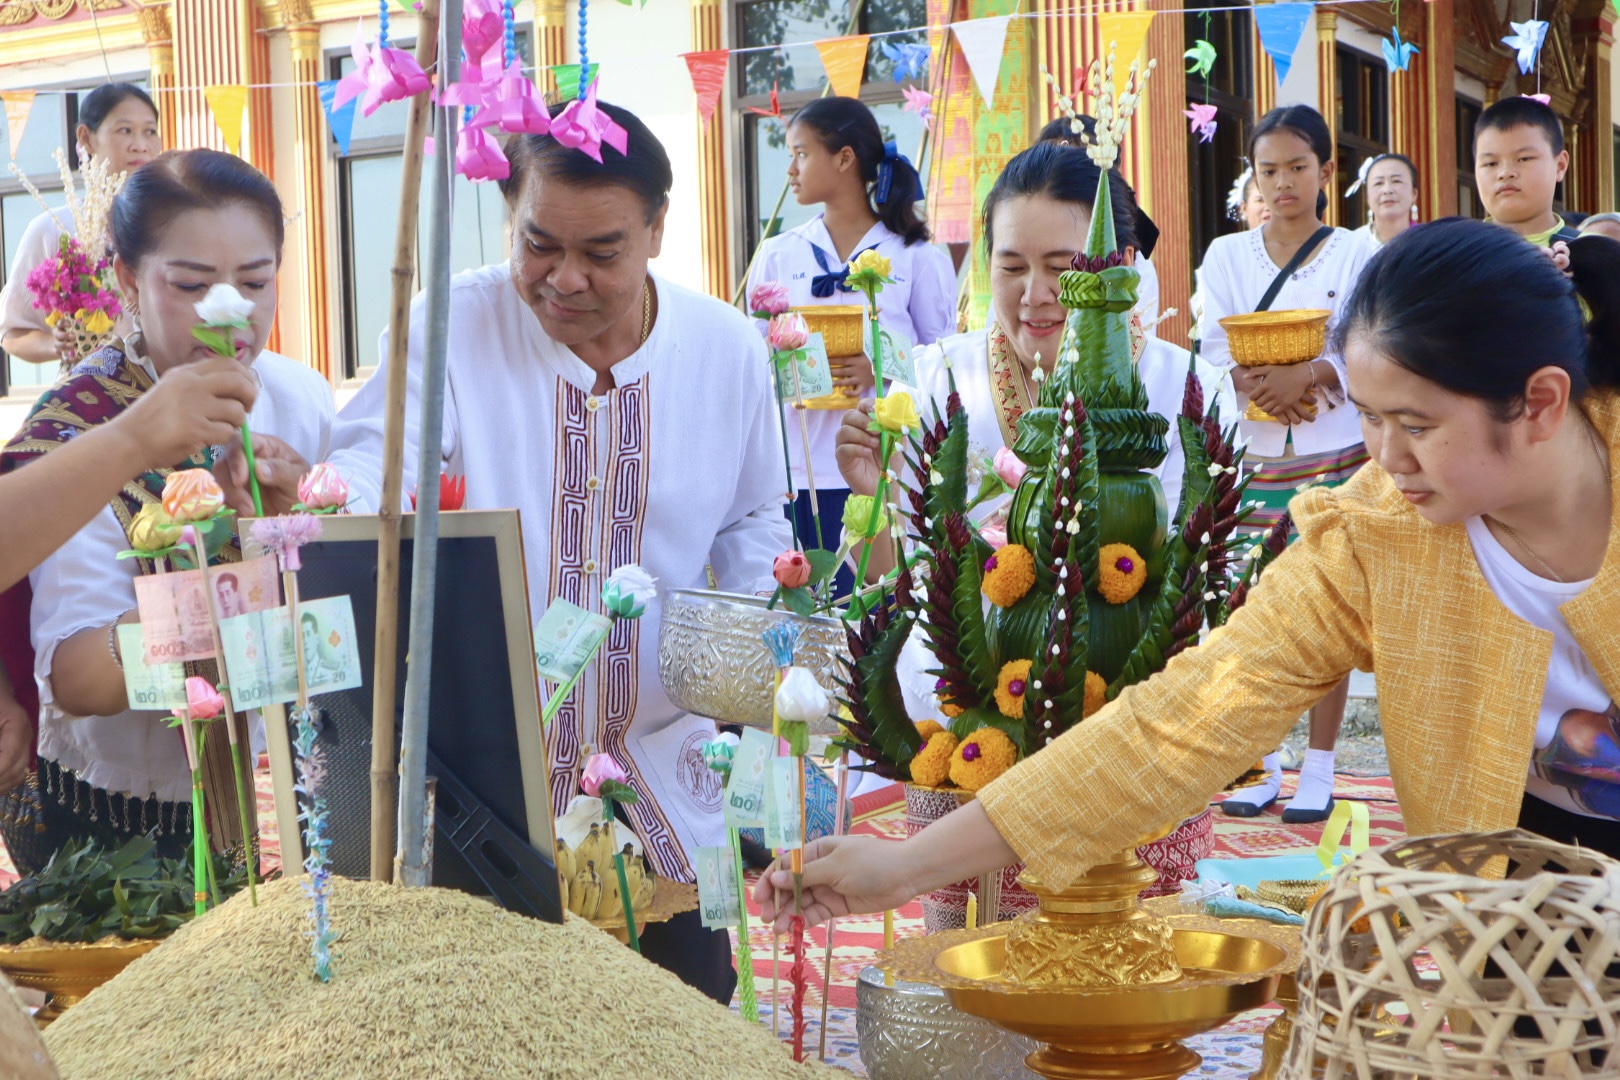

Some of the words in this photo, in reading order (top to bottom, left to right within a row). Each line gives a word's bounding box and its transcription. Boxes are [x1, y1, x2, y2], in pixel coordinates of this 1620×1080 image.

[332, 671, 346, 683] 20
[729, 791, 753, 811] ๒๐
[704, 905, 722, 920] ๒๐
